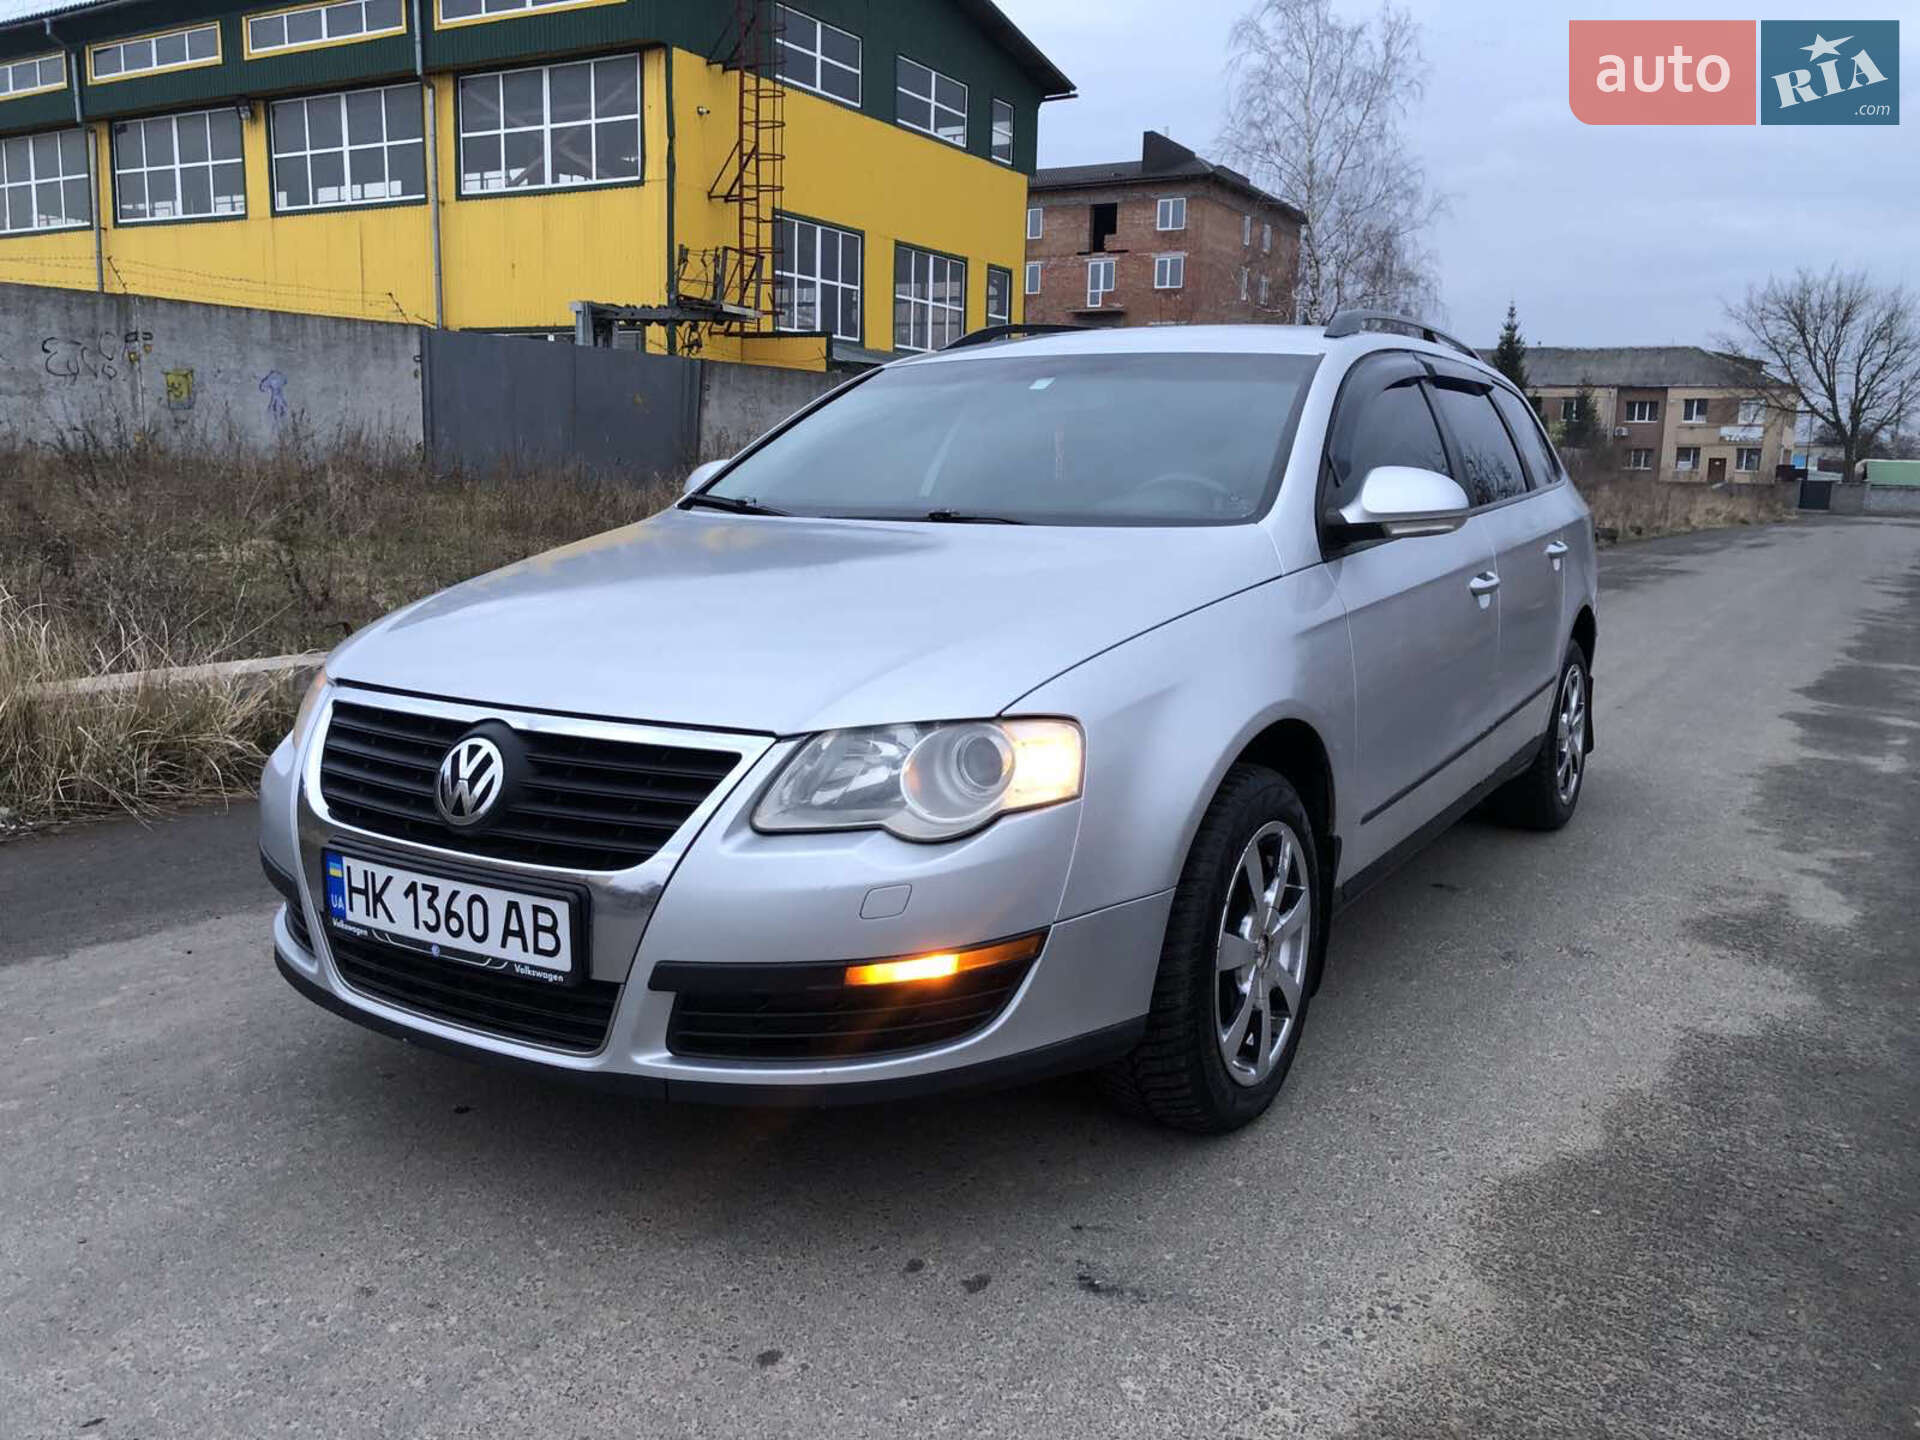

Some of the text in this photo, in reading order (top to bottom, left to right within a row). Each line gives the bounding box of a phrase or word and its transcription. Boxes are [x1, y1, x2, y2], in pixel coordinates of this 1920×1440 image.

[330, 894, 345, 910] UA
[346, 865, 562, 958] HK 1360 AB
[514, 962, 564, 983] Volkswagen
